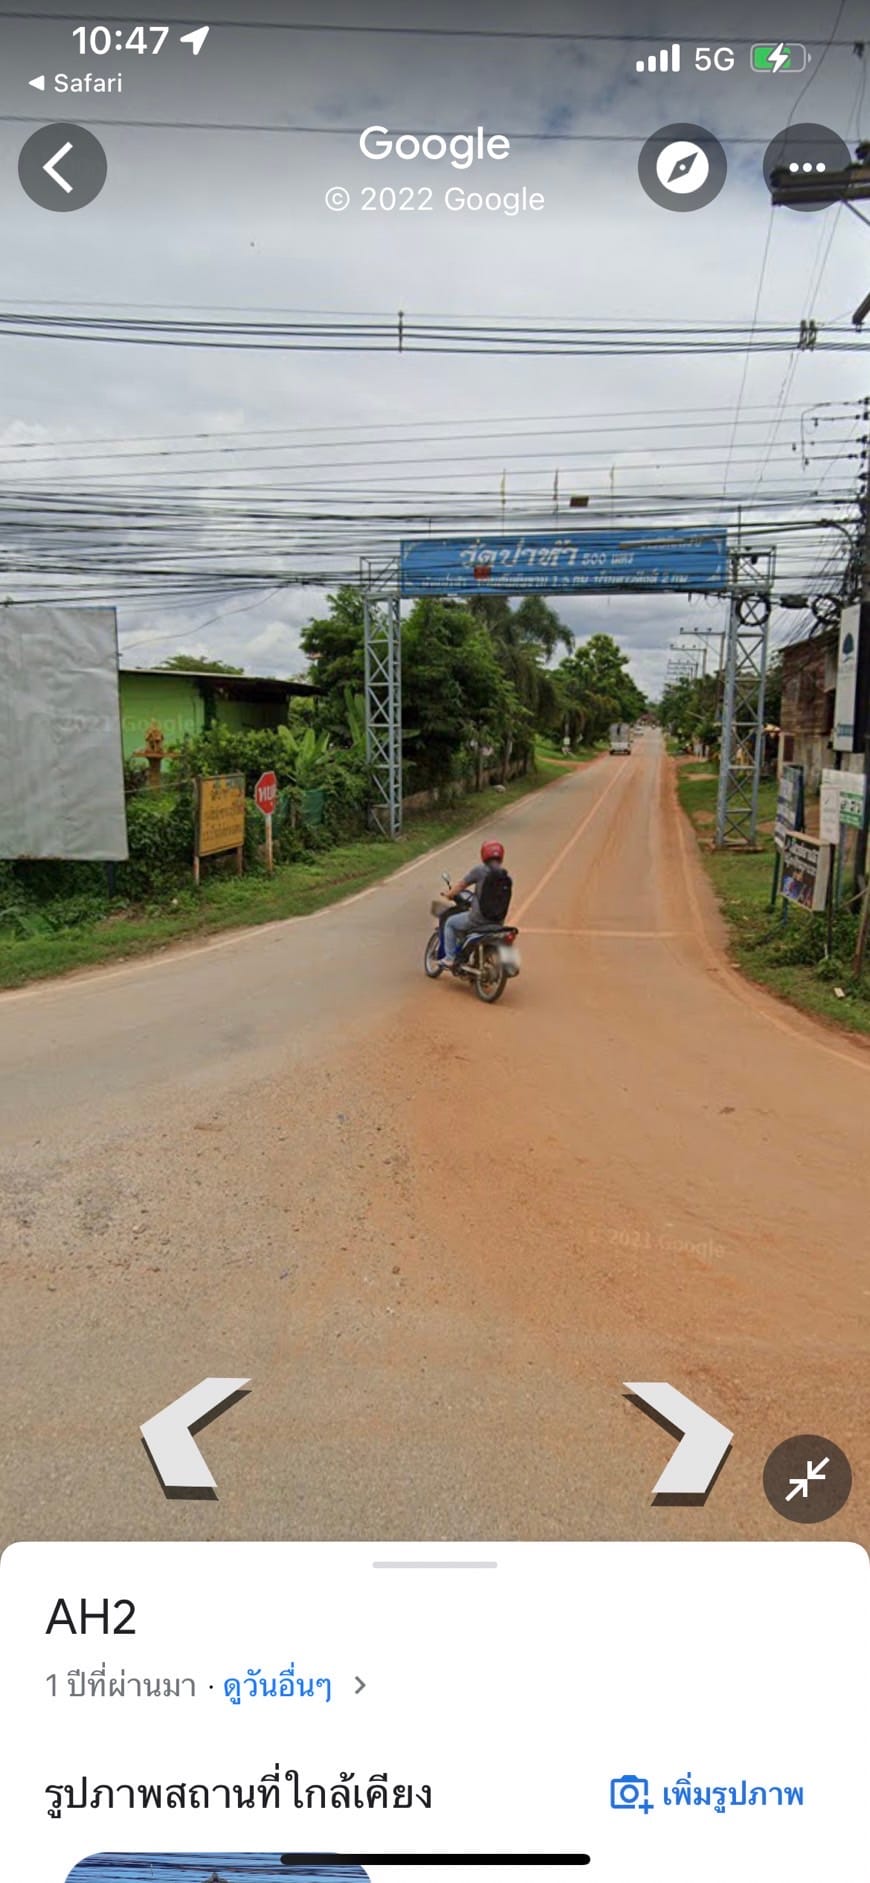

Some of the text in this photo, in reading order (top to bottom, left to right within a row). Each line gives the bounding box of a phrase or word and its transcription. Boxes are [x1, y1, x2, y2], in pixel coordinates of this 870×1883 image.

[72, 27, 169, 55] 10:47
[695, 47, 735, 71] 5G
[54, 73, 122, 93] Safari
[581, 552, 607, 566] 500
[45, 1598, 136, 1635] AH2
[46, 1662, 331, 1705] 1 ปีที่ผ่านมา ดูวันอื่นๆ
[44, 1763, 433, 1820] รูปภาพสถานที่ใกล้เคียง
[663, 1772, 805, 1814] เพิ่มรูปภาพ
